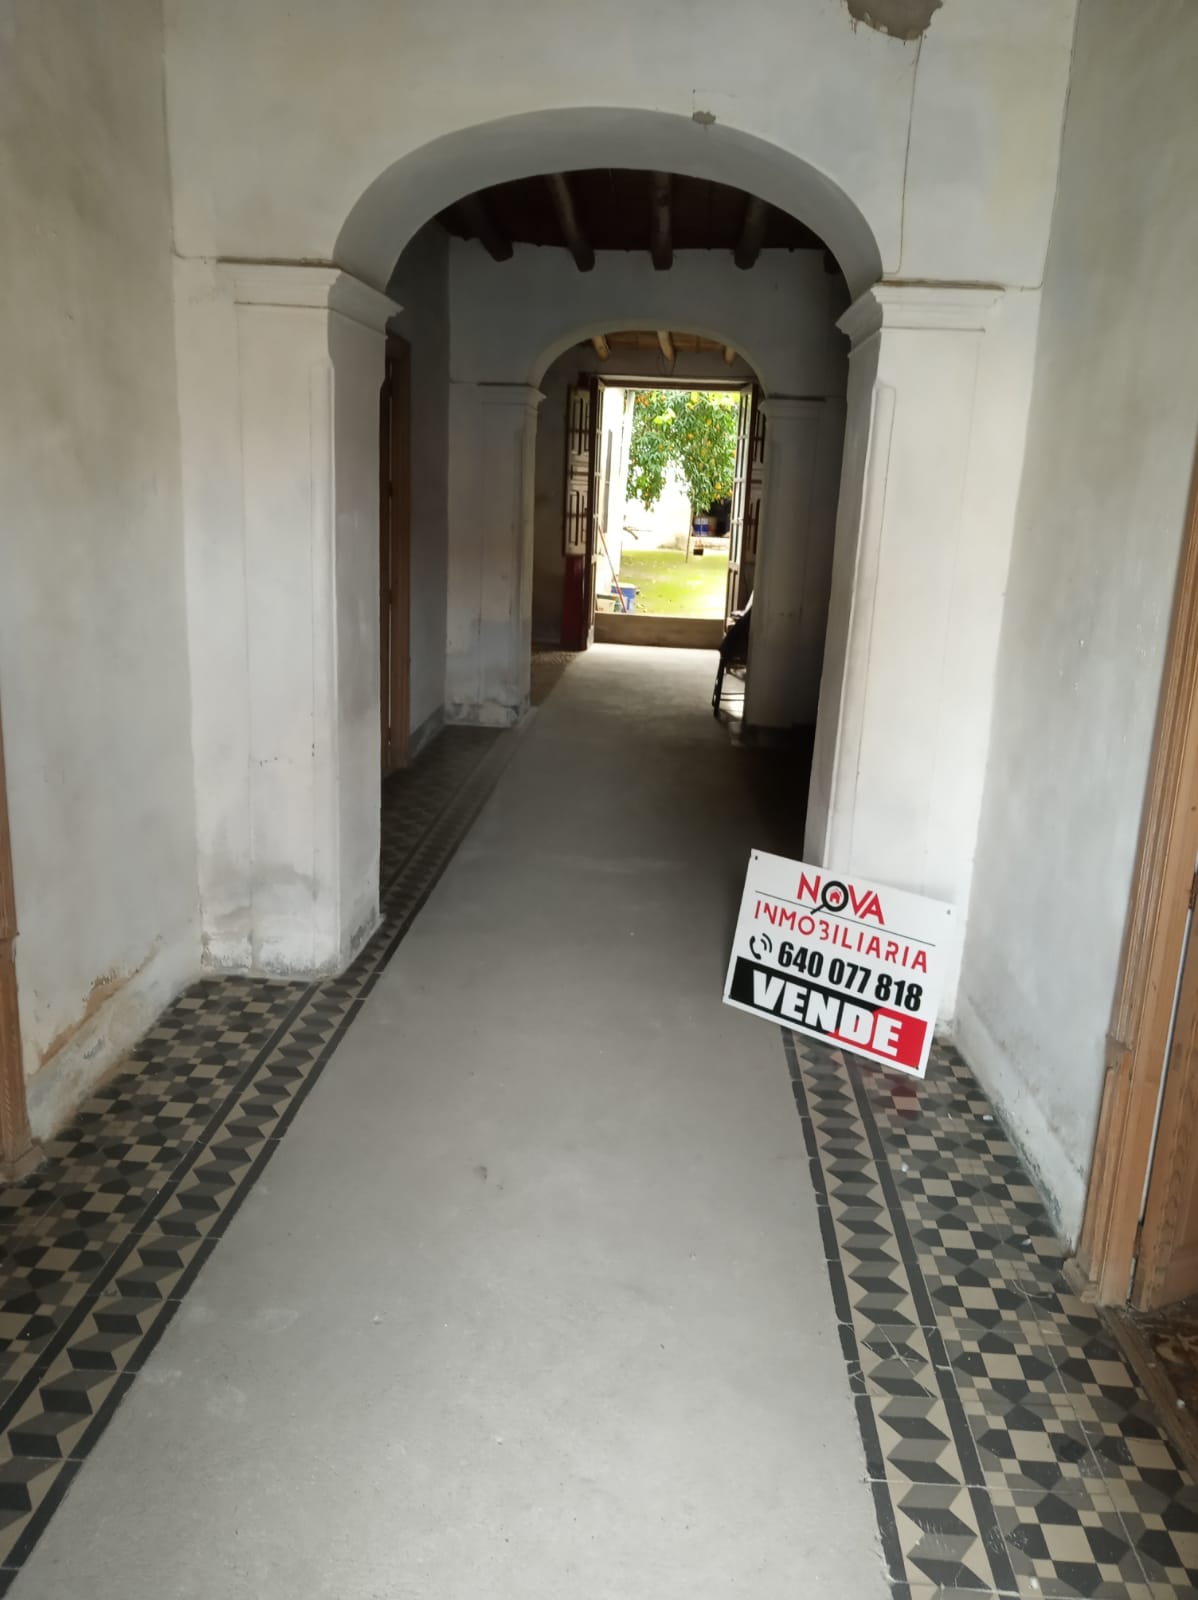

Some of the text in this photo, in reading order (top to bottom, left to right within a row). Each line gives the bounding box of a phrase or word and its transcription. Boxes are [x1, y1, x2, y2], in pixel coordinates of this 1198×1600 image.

[797, 872, 885, 925] NOVA
[778, 941, 923, 1012] 640 077 818
[752, 969, 903, 1057] VENDE
